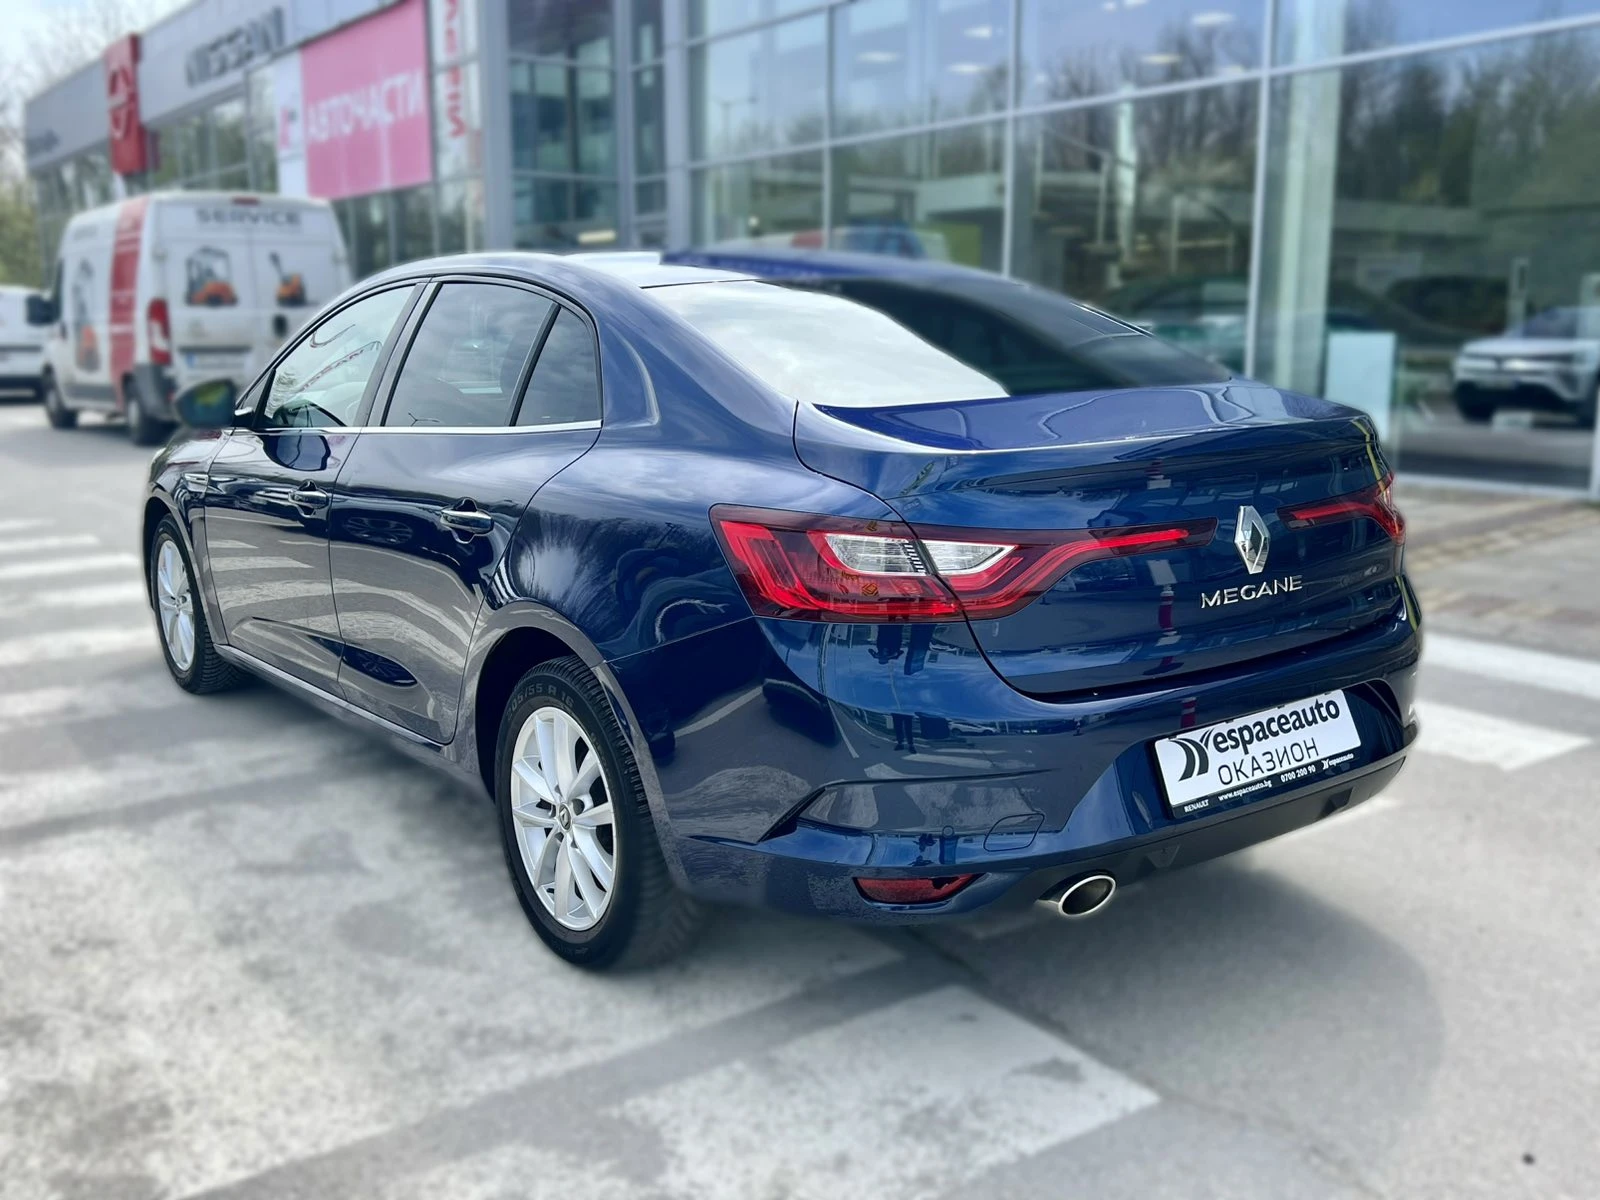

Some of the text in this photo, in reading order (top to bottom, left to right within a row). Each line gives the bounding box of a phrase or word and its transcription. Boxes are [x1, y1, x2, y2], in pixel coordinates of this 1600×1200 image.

[184, 5, 285, 88] NISSAN
[307, 70, 423, 142] АВТОЧАСТИ
[196, 208, 302, 226] SERVICE
[1201, 574, 1303, 609] MEGANE
[1212, 698, 1340, 755] espaceauto
[1217, 737, 1320, 785] ОКАЗИОН
[1280, 765, 1316, 783] 0700 200 90
[1328, 753, 1354, 767] espaceauto
[1218, 779, 1273, 802] www.espaceauto.bg
[1184, 799, 1209, 813] RENAULT
